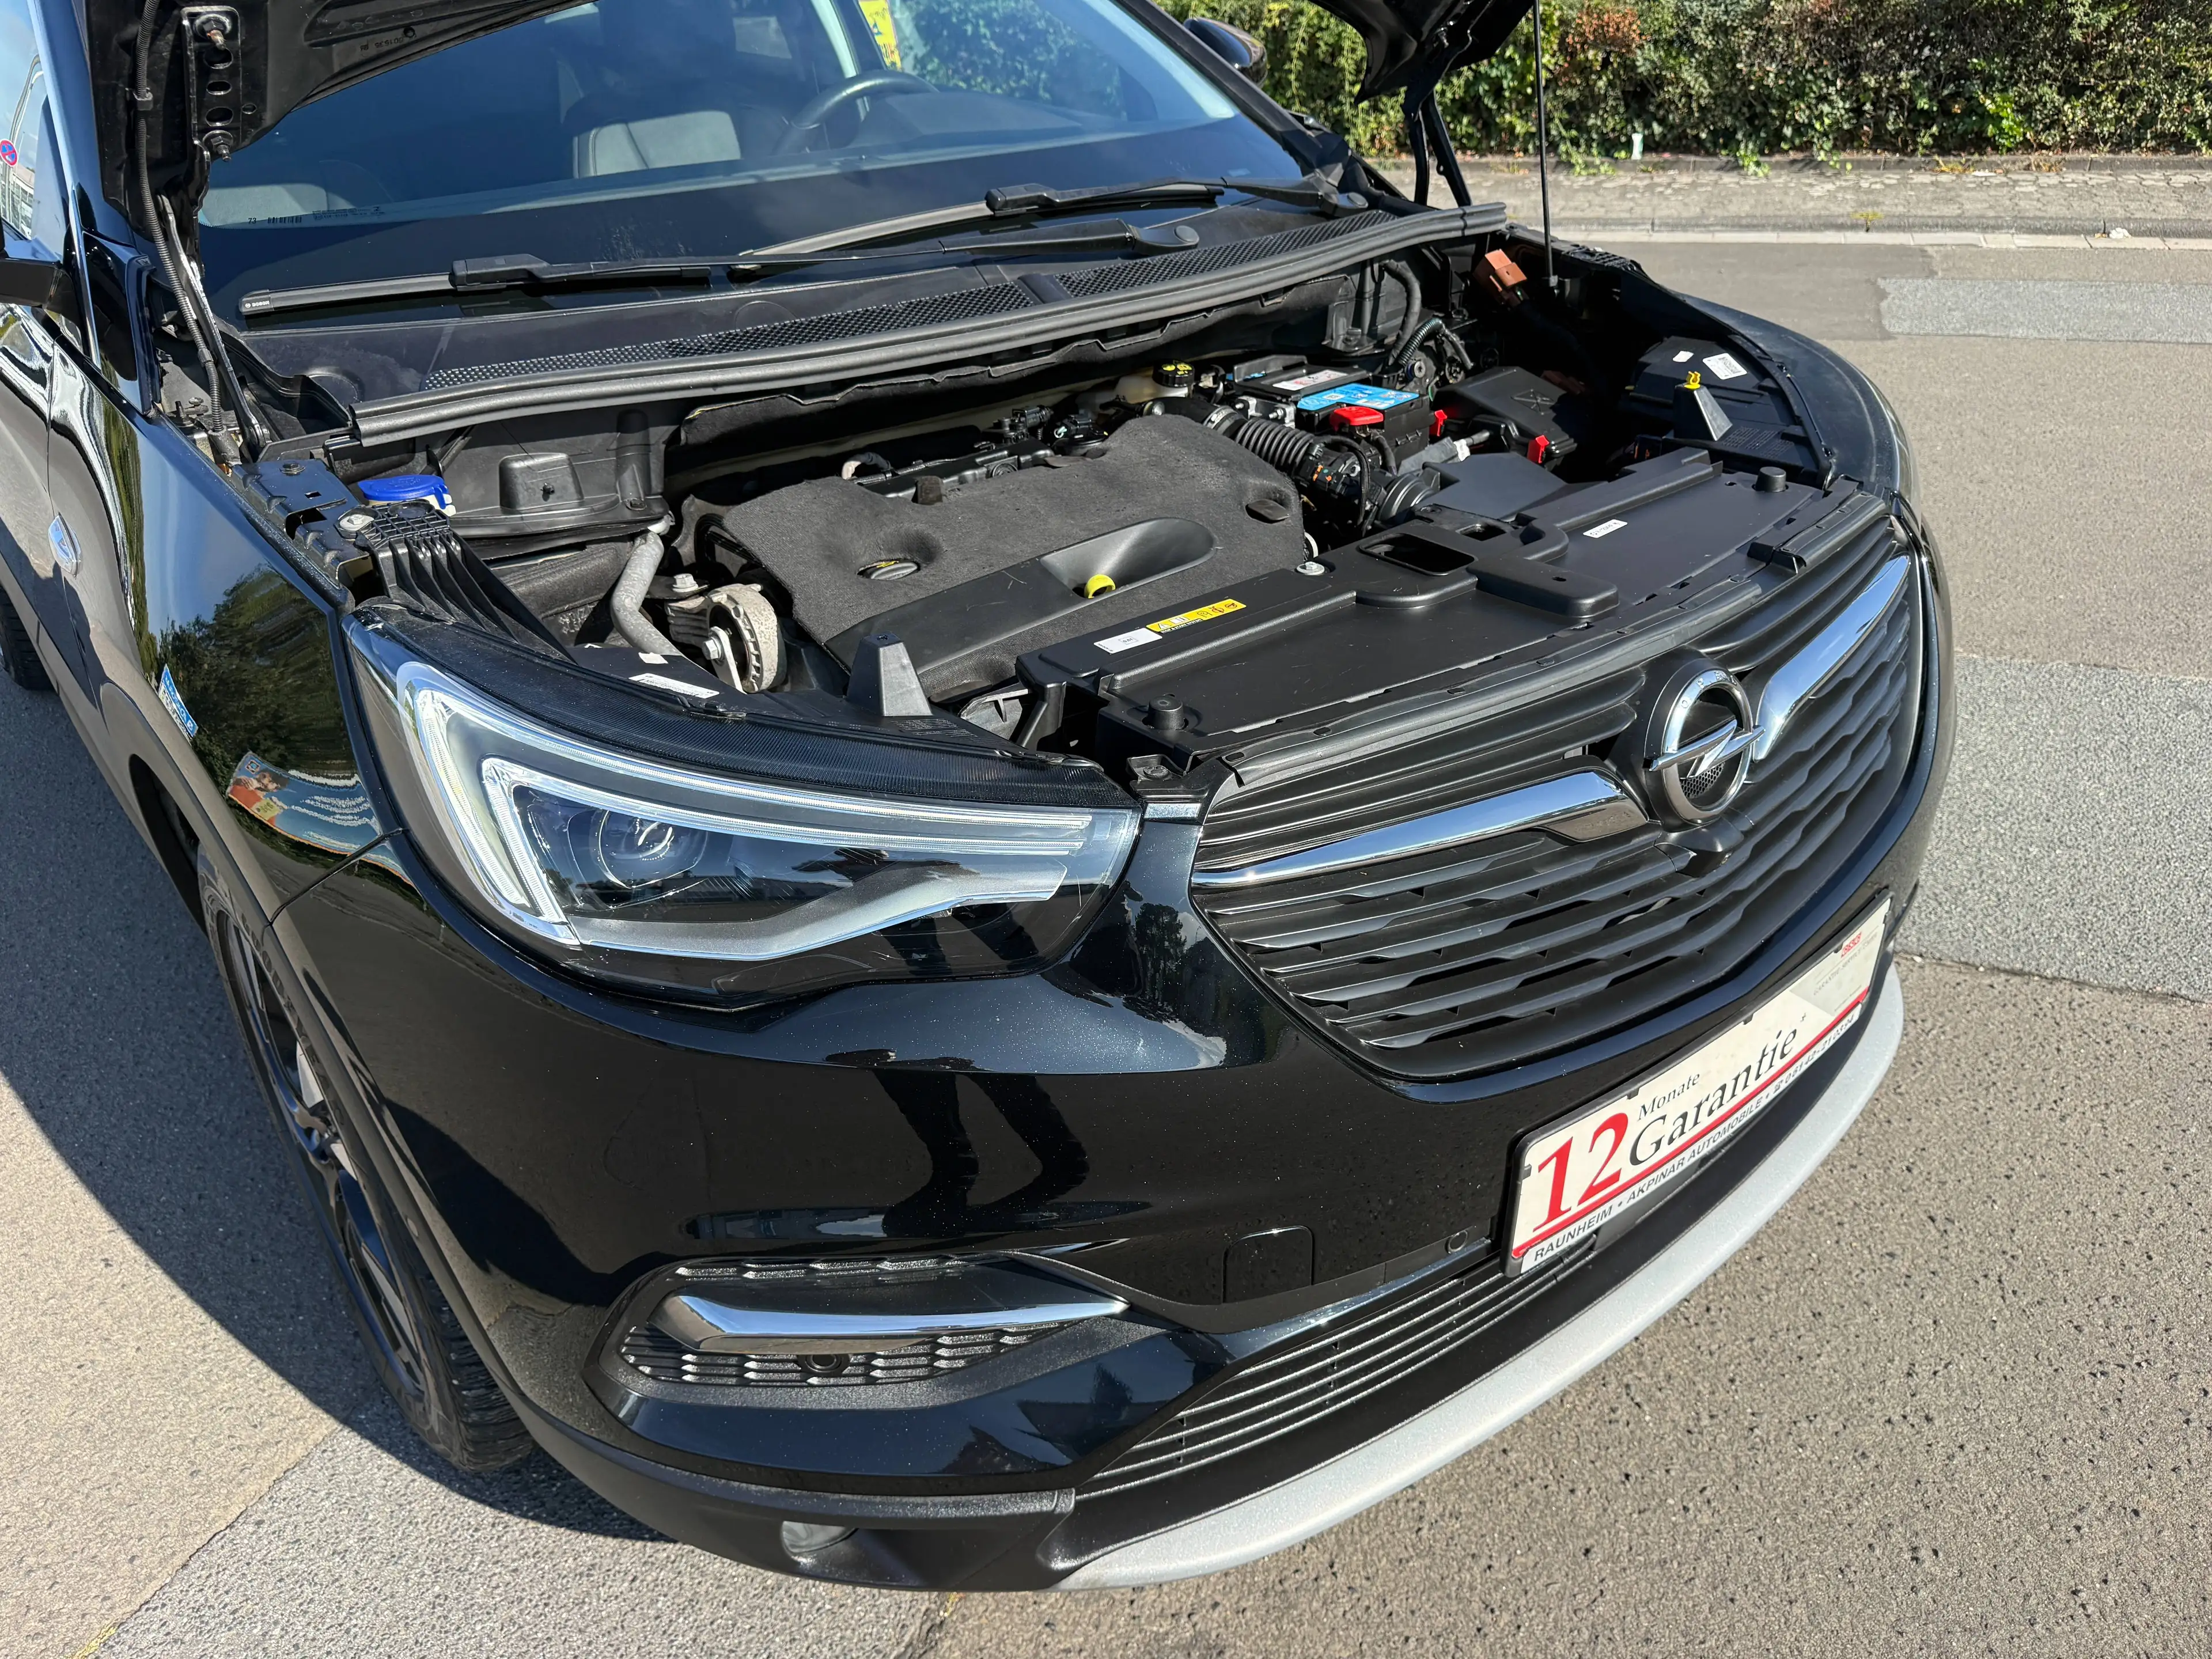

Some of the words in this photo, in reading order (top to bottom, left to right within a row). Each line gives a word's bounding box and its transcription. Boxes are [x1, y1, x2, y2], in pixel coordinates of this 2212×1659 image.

[1681, 671, 1737, 709] OPEL
[1630, 1029, 1797, 1166] Garantie
[1637, 1073, 1700, 1122] Monate
[1533, 1113, 1628, 1232] 12
[1534, 1205, 1612, 1262] RAUNHEIM
[1626, 1156, 1685, 1204] AKPINAR
[1687, 1096, 1763, 1161] AUTOMOBILE
